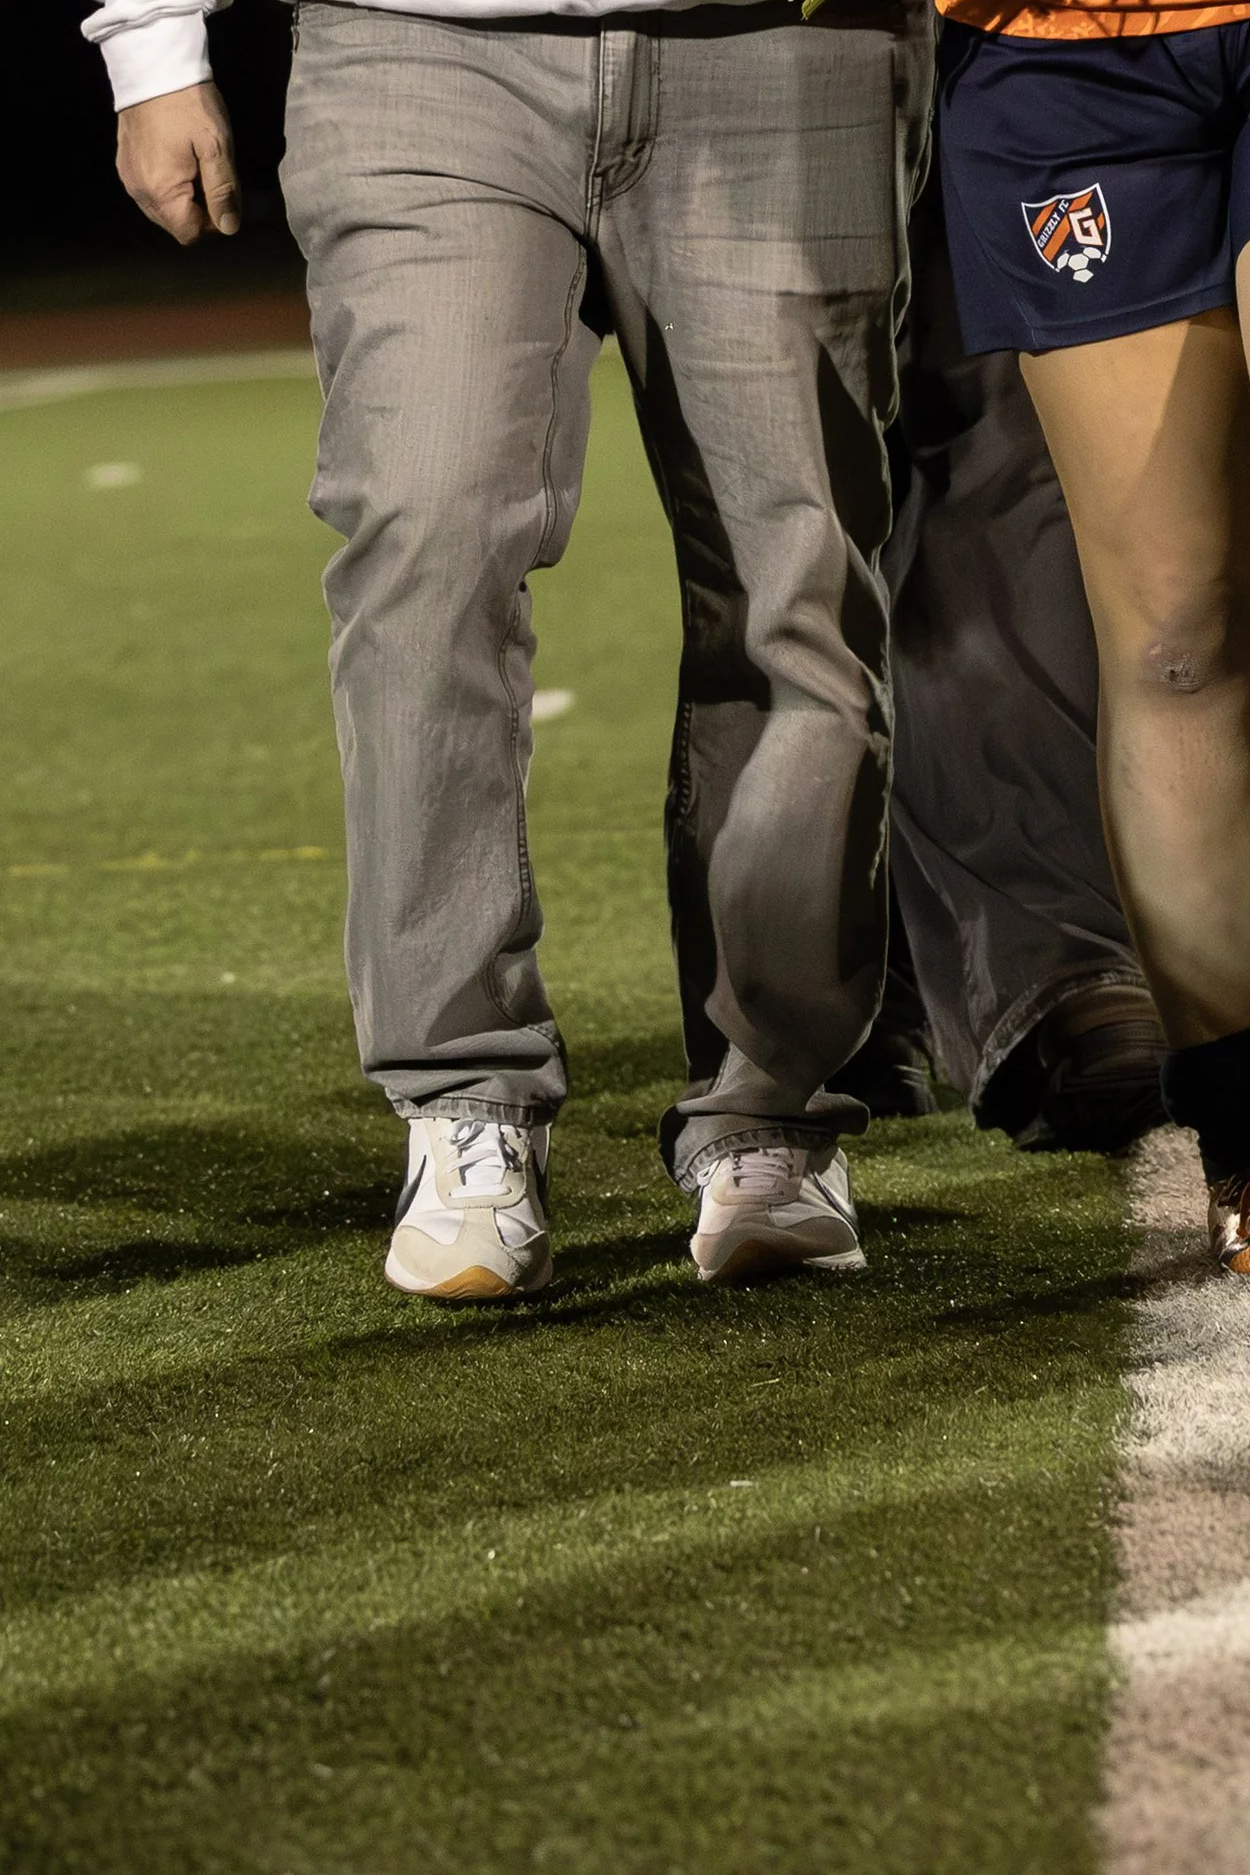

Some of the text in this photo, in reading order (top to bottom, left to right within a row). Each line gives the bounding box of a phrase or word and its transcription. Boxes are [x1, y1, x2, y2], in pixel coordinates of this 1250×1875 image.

[1037, 199, 1069, 248] GRIZZLY FC
[1069, 207, 1103, 246] G
